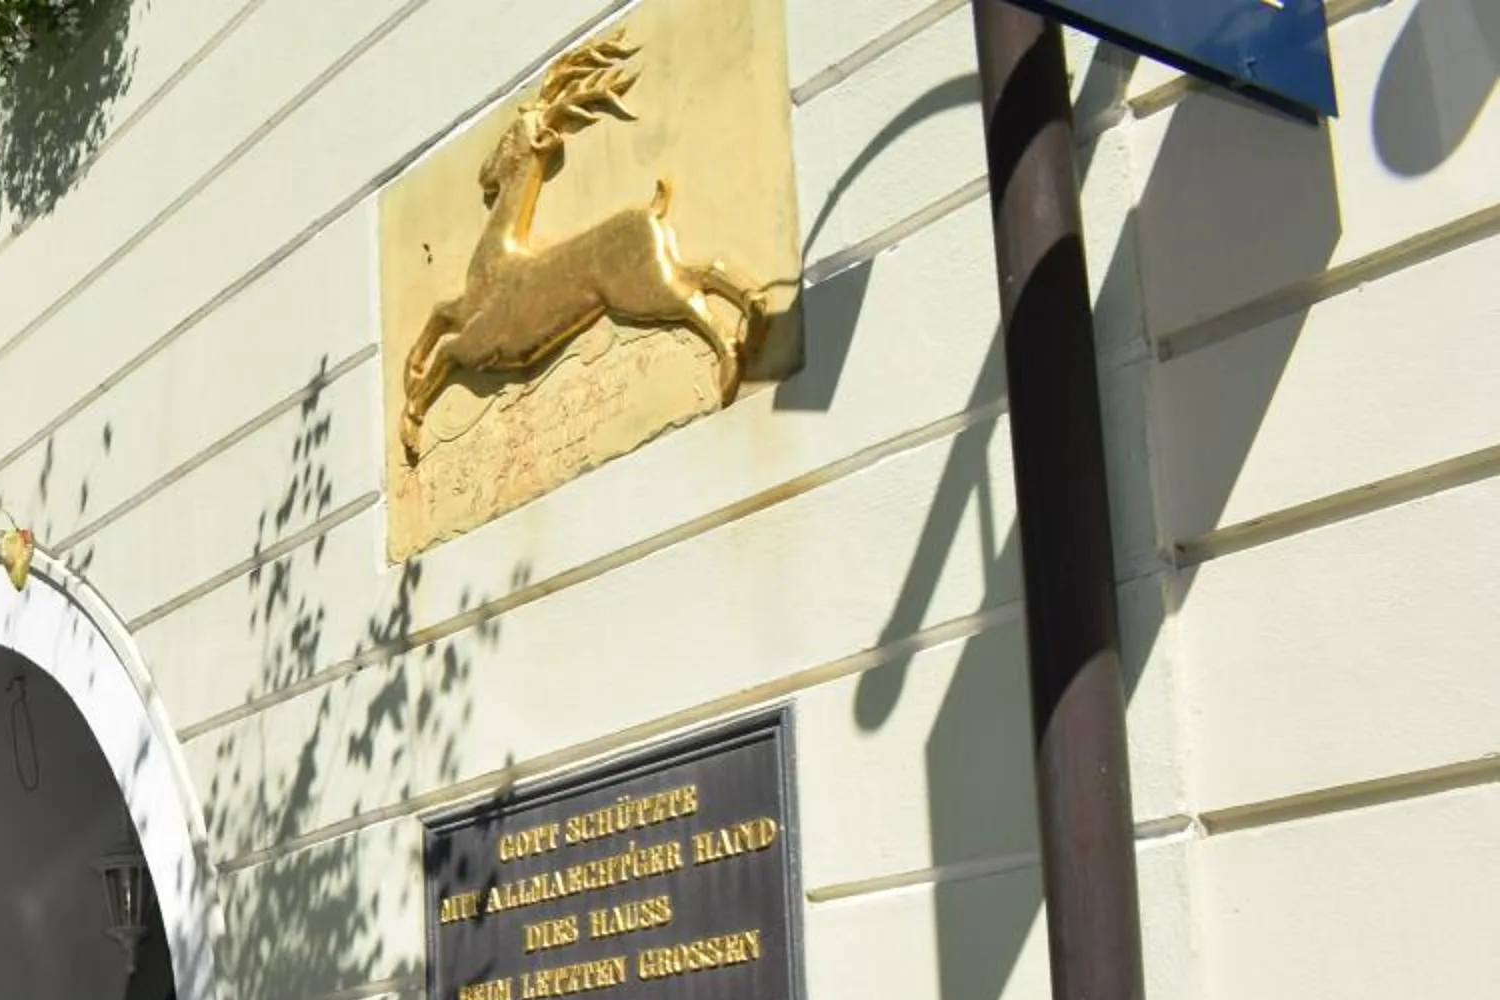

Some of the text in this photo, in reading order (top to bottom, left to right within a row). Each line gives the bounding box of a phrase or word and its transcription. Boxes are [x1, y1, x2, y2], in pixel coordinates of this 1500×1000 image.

[500, 784, 699, 863] GOTT SCHÜTZTE
[692, 817, 777, 865] HAND
[524, 916, 580, 952] DIES
[520, 956, 629, 1000] LETZTEN
[637, 930, 761, 982] GROSSEN
